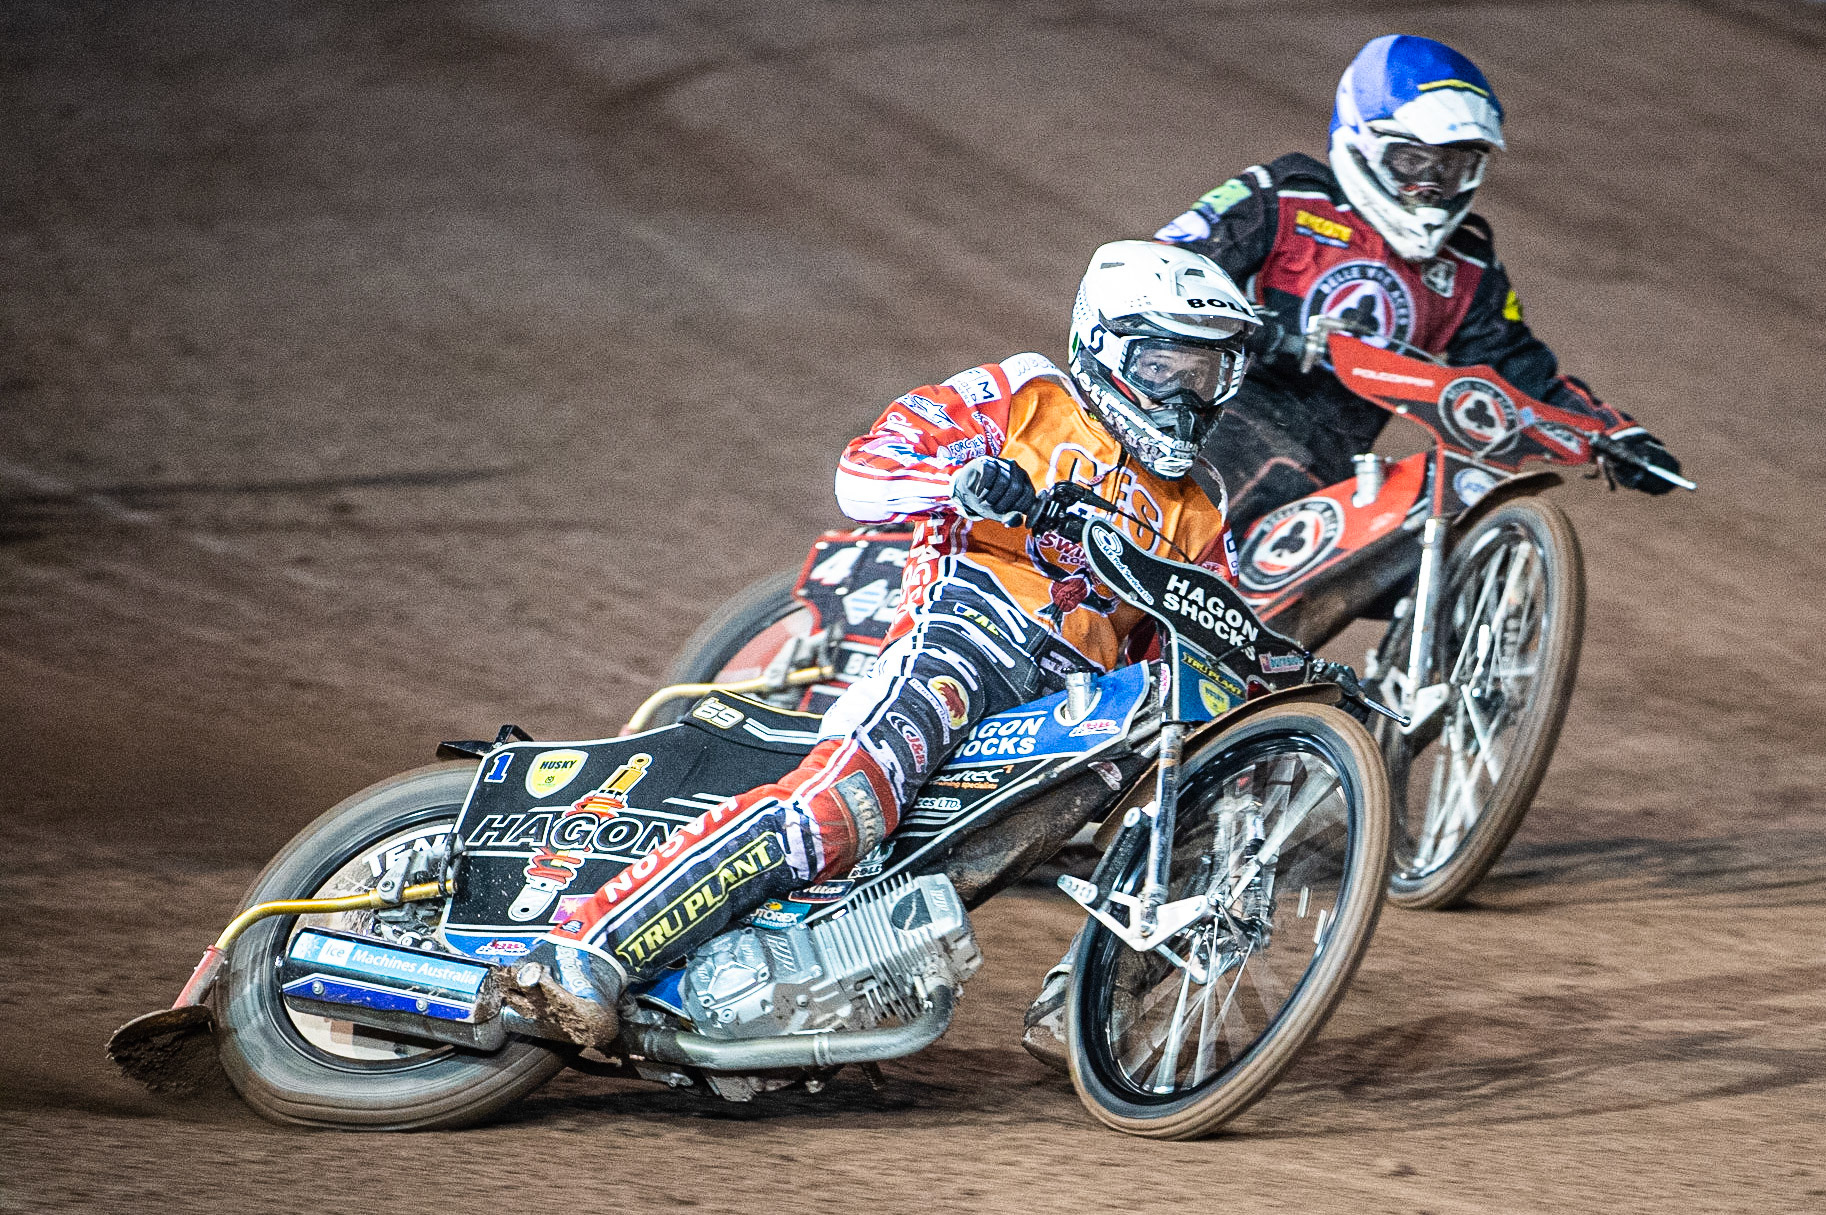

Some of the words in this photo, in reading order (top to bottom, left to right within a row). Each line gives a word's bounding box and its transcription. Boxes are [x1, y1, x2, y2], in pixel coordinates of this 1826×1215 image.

[1162, 592, 1256, 661] SHOCKS
[1166, 574, 1258, 641] HAGON
[485, 752, 514, 783] 1
[539, 759, 577, 771] HUSKY
[465, 813, 684, 856] HAGON
[628, 908, 684, 962] TRU
[683, 840, 774, 922] PLANT
[352, 949, 417, 973] Machines
[417, 961, 478, 985] Australia
